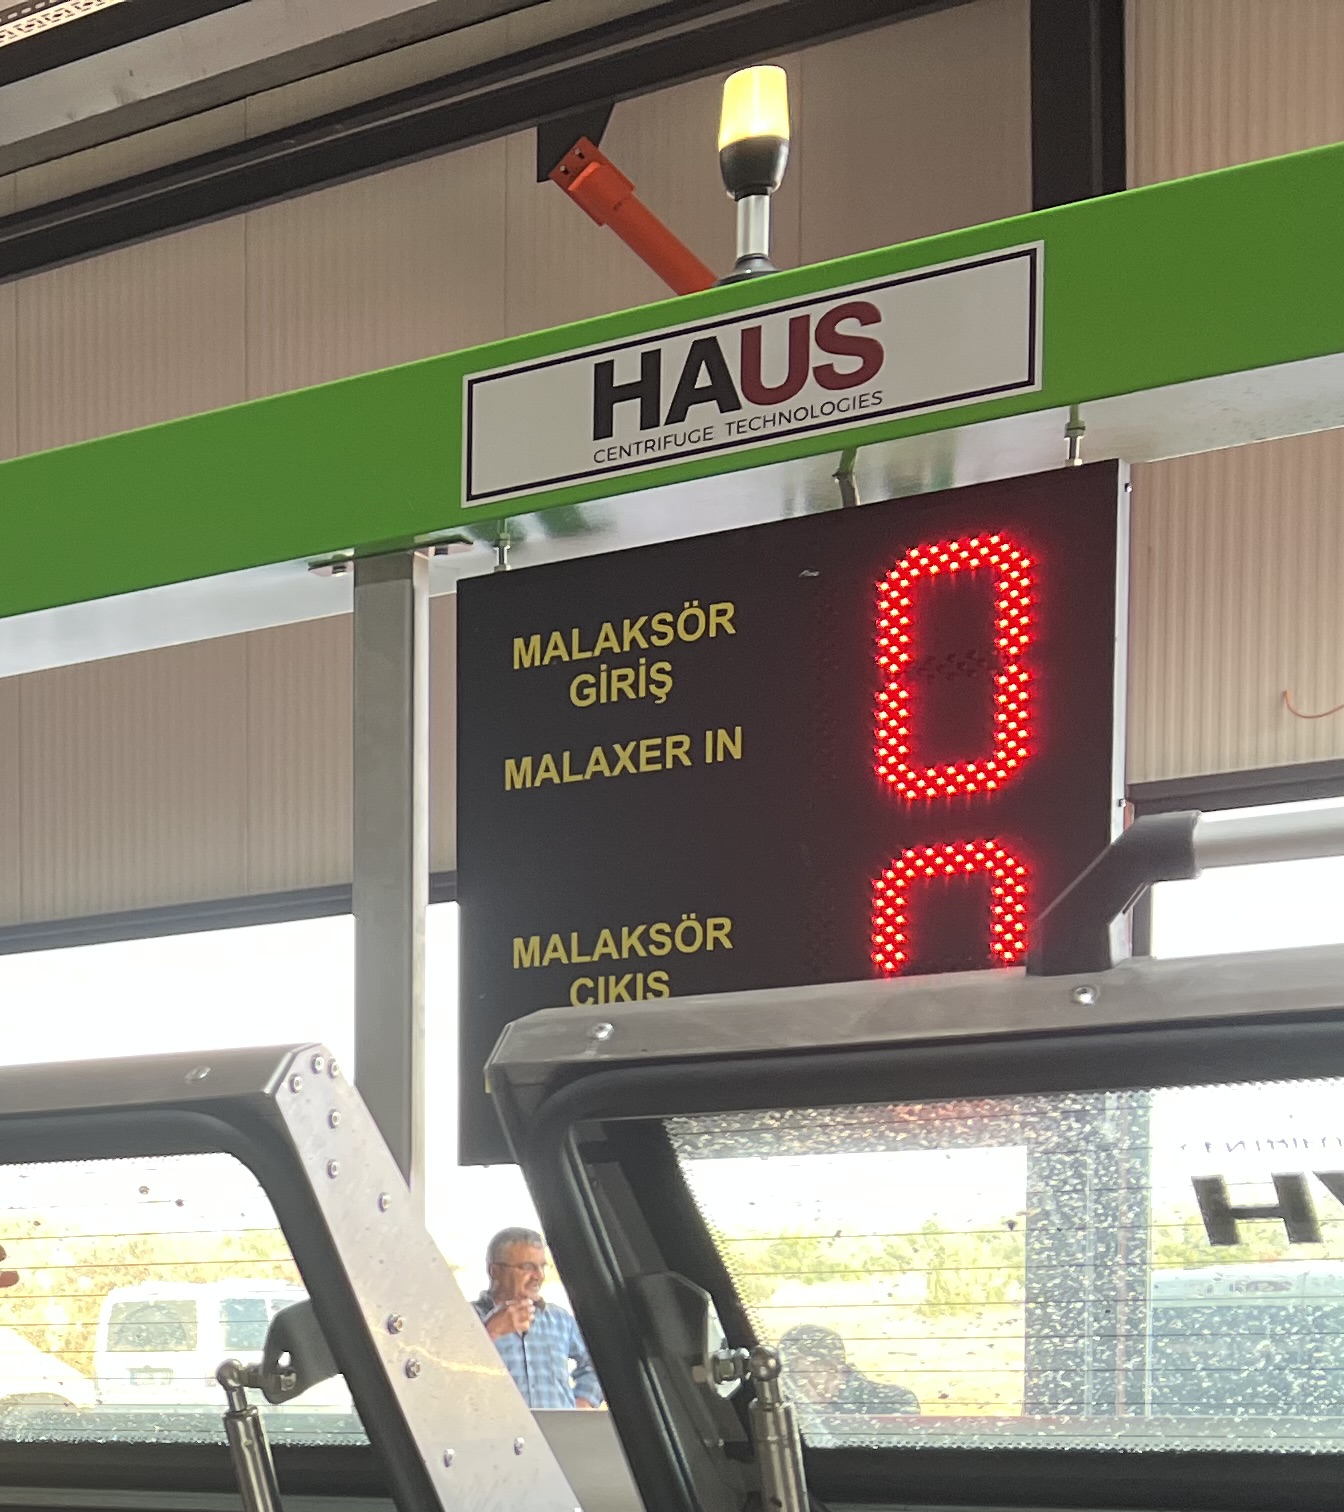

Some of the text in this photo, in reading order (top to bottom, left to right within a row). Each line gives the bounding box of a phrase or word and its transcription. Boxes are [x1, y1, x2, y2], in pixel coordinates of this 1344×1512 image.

[592, 300, 885, 441] HAUS
[592, 390, 883, 464] CENTRIFUGE TECHNOLOGIES
[513, 600, 737, 670] MALAKSÖR
[873, 531, 1035, 801] 0
[569, 657, 673, 708] GİRİŞ
[505, 726, 743, 791] MALAXER IN
[513, 912, 734, 970] MALAKSÖR
